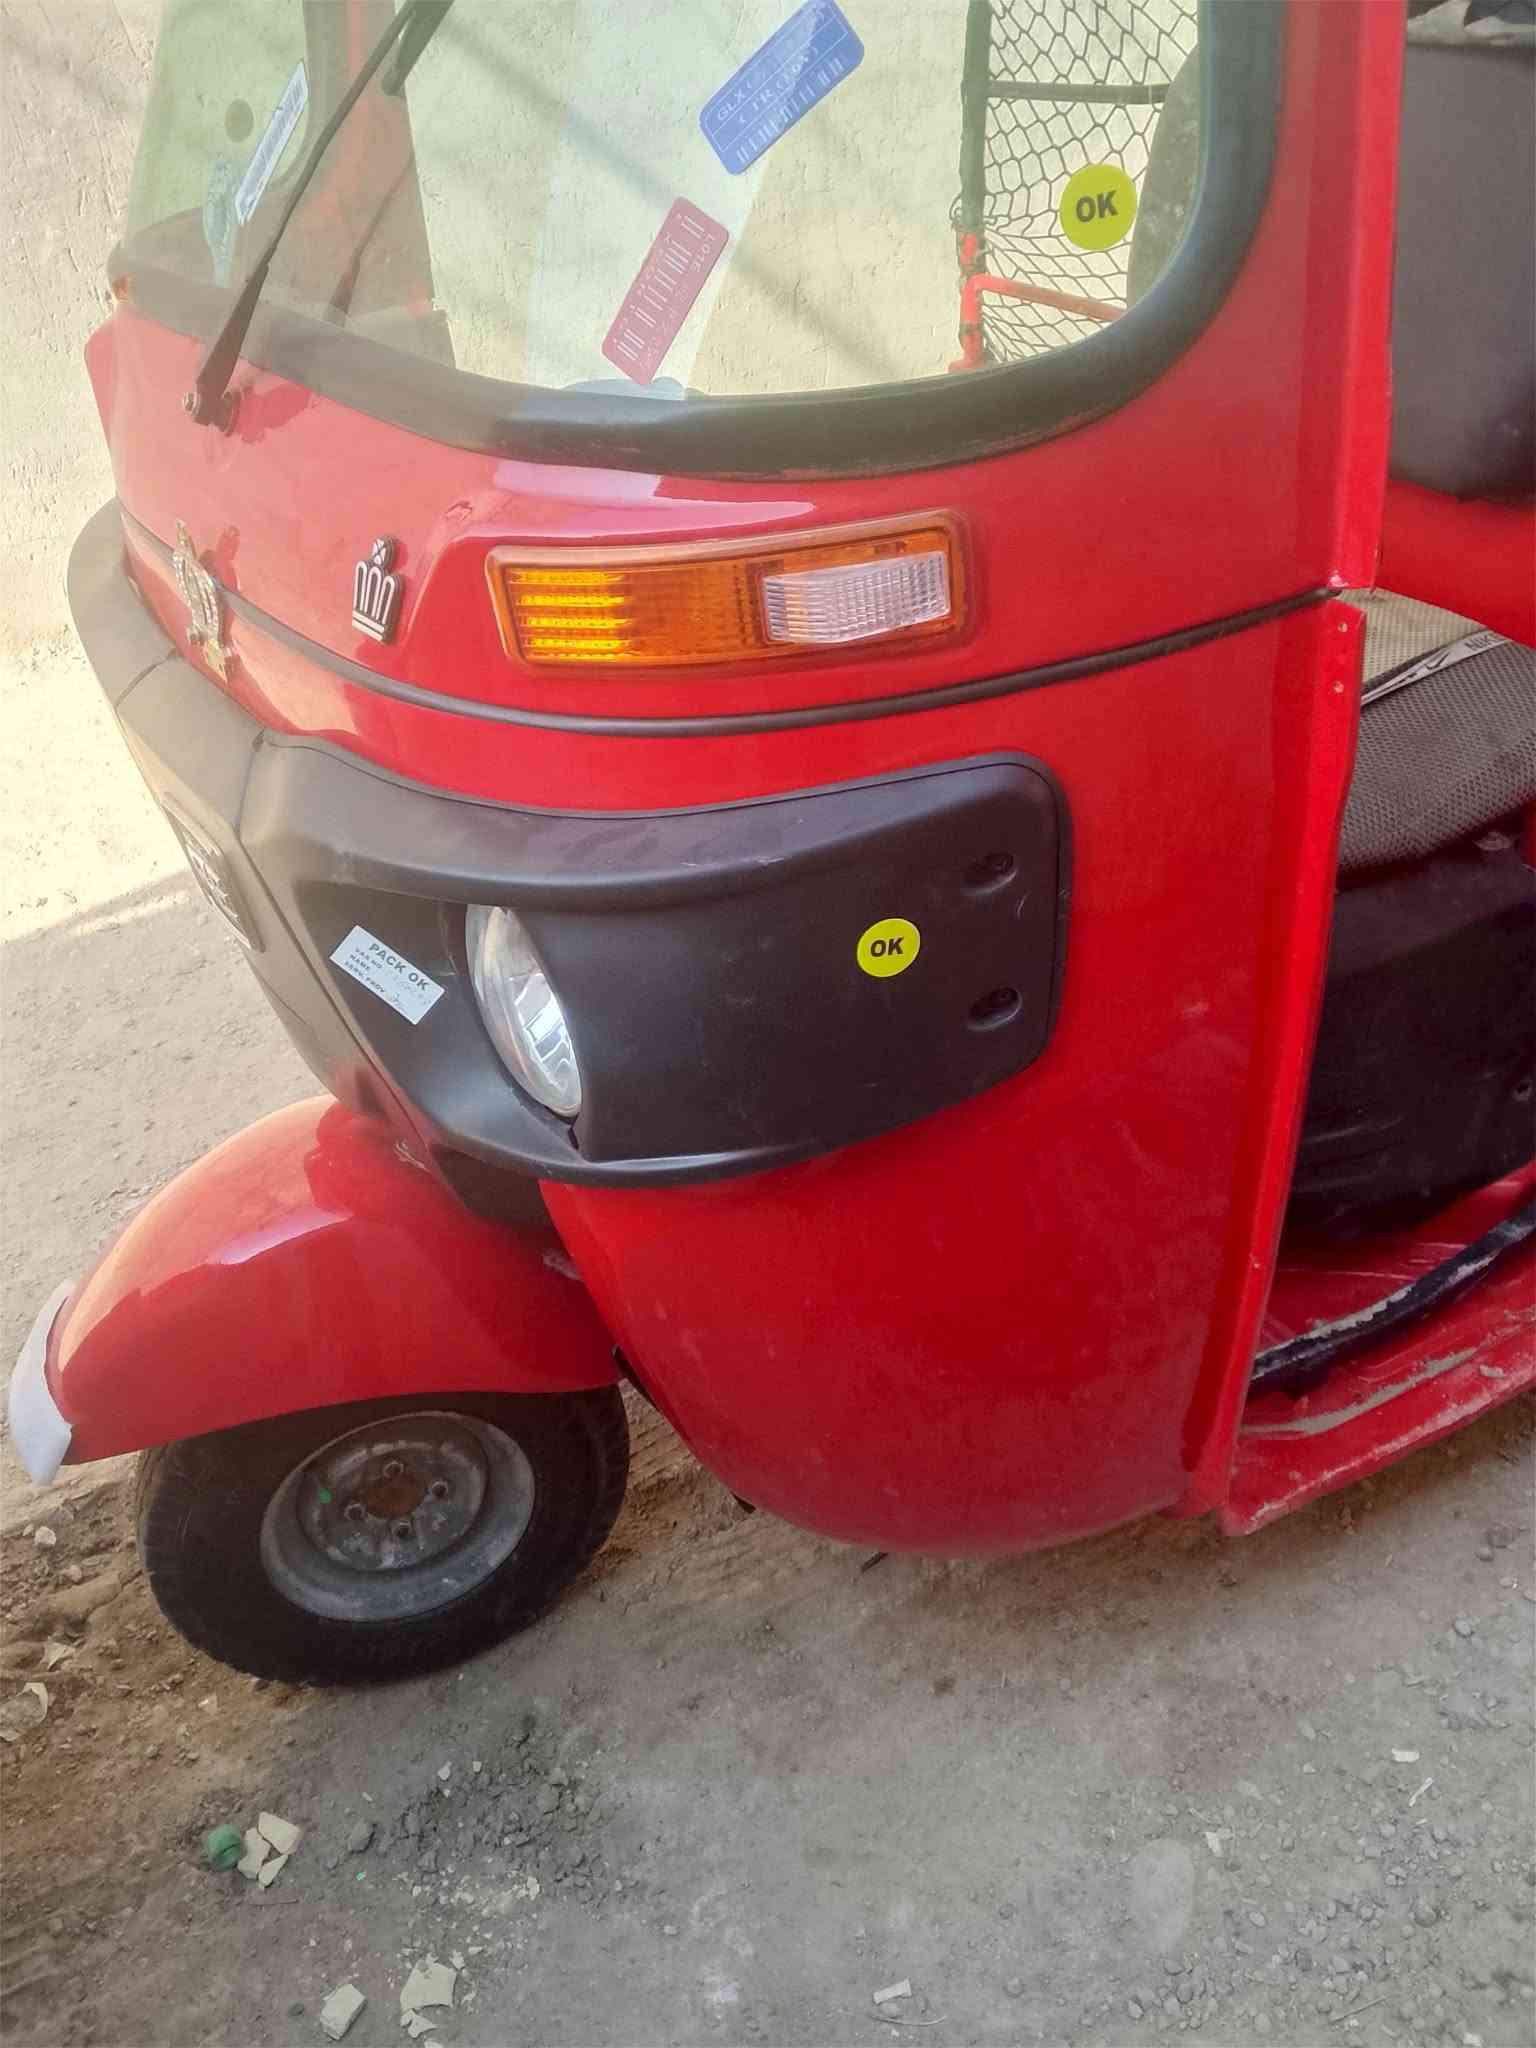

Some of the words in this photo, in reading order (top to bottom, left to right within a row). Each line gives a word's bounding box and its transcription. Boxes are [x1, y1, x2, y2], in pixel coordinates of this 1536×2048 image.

[1076, 190, 1118, 223] OK
[871, 936, 904, 957] OK
[369, 943, 406, 973] PACK
[408, 972, 430, 990] OK
